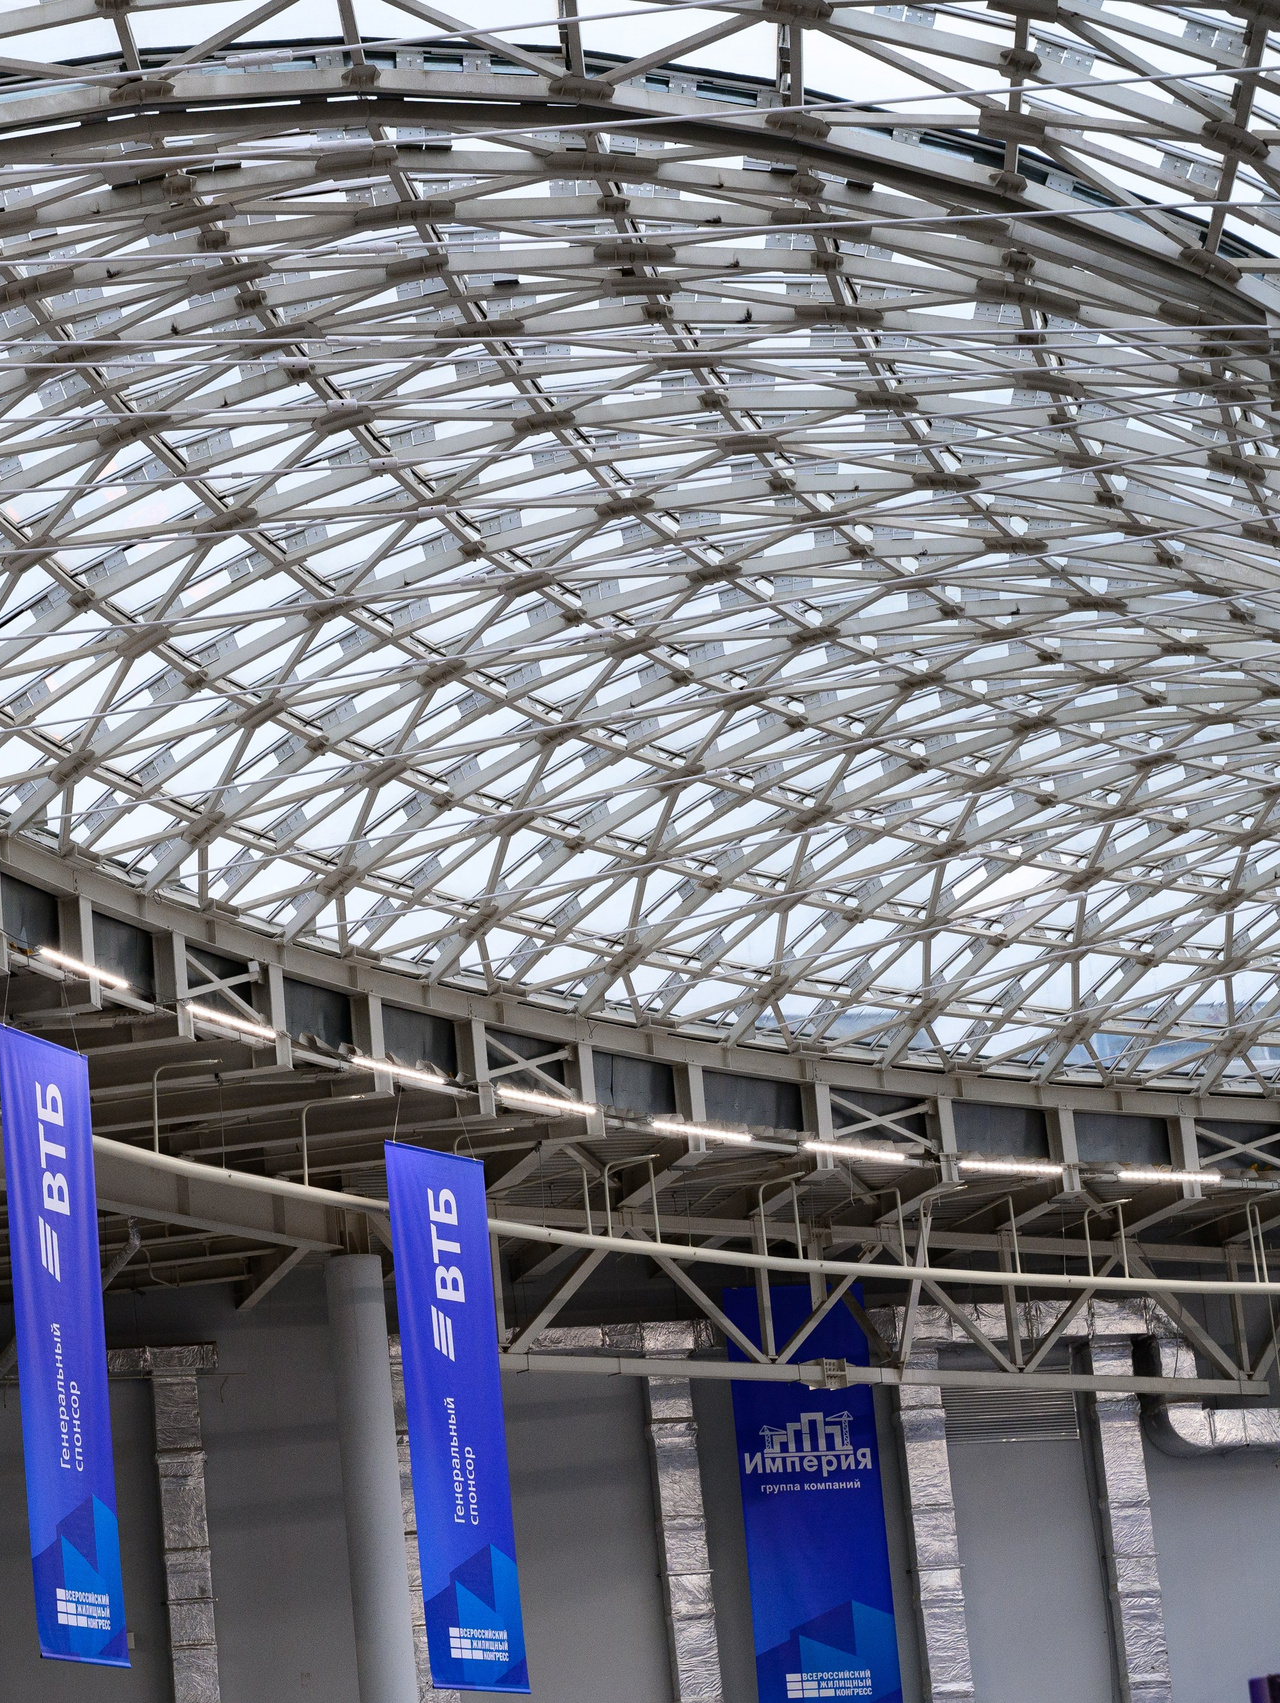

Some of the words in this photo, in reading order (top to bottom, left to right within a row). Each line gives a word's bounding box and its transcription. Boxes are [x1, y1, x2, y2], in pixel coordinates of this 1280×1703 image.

[35, 1081, 70, 1216] ВТБ
[427, 1187, 465, 1303] ВТБ
[50, 1322, 71, 1469] Генеральный
[69, 1380, 84, 1472] спонсор
[443, 1397, 466, 1523] Генеральный
[464, 1446, 479, 1526] спонсор
[760, 1483, 801, 1495] группа
[804, 1478, 861, 1491] компаний
[460, 1628, 508, 1640] ВСЕРОССИЙСКИЙ
[471, 1639, 509, 1651] ЖИЛИЩНЫЙ
[801, 1669, 871, 1681] ВСЕРОССИЙСКИЙ
[819, 1677, 872, 1689] ЖИЛИЩНЫЙ
[835, 1687, 873, 1697] КОНГРЕСС
